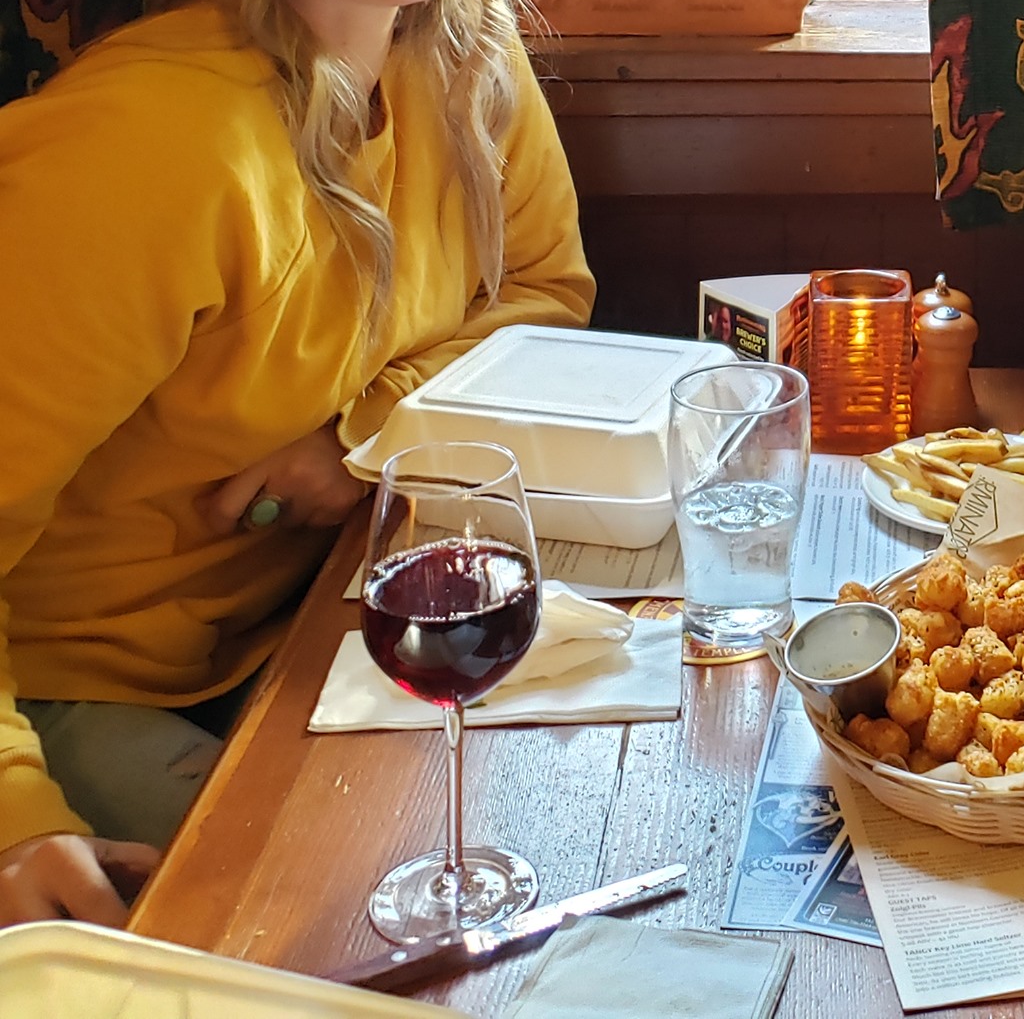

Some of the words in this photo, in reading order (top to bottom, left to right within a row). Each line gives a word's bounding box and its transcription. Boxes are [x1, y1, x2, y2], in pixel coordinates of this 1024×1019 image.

[740, 338, 762, 353] CHOICE
[888, 896, 914, 905] GUEST
[916, 895, 937, 903] TAPS
[905, 947, 932, 956] TANGY
[934, 945, 950, 953] Key
[973, 938, 993, 946] Hard
[994, 932, 1021, 941] Seltzer
